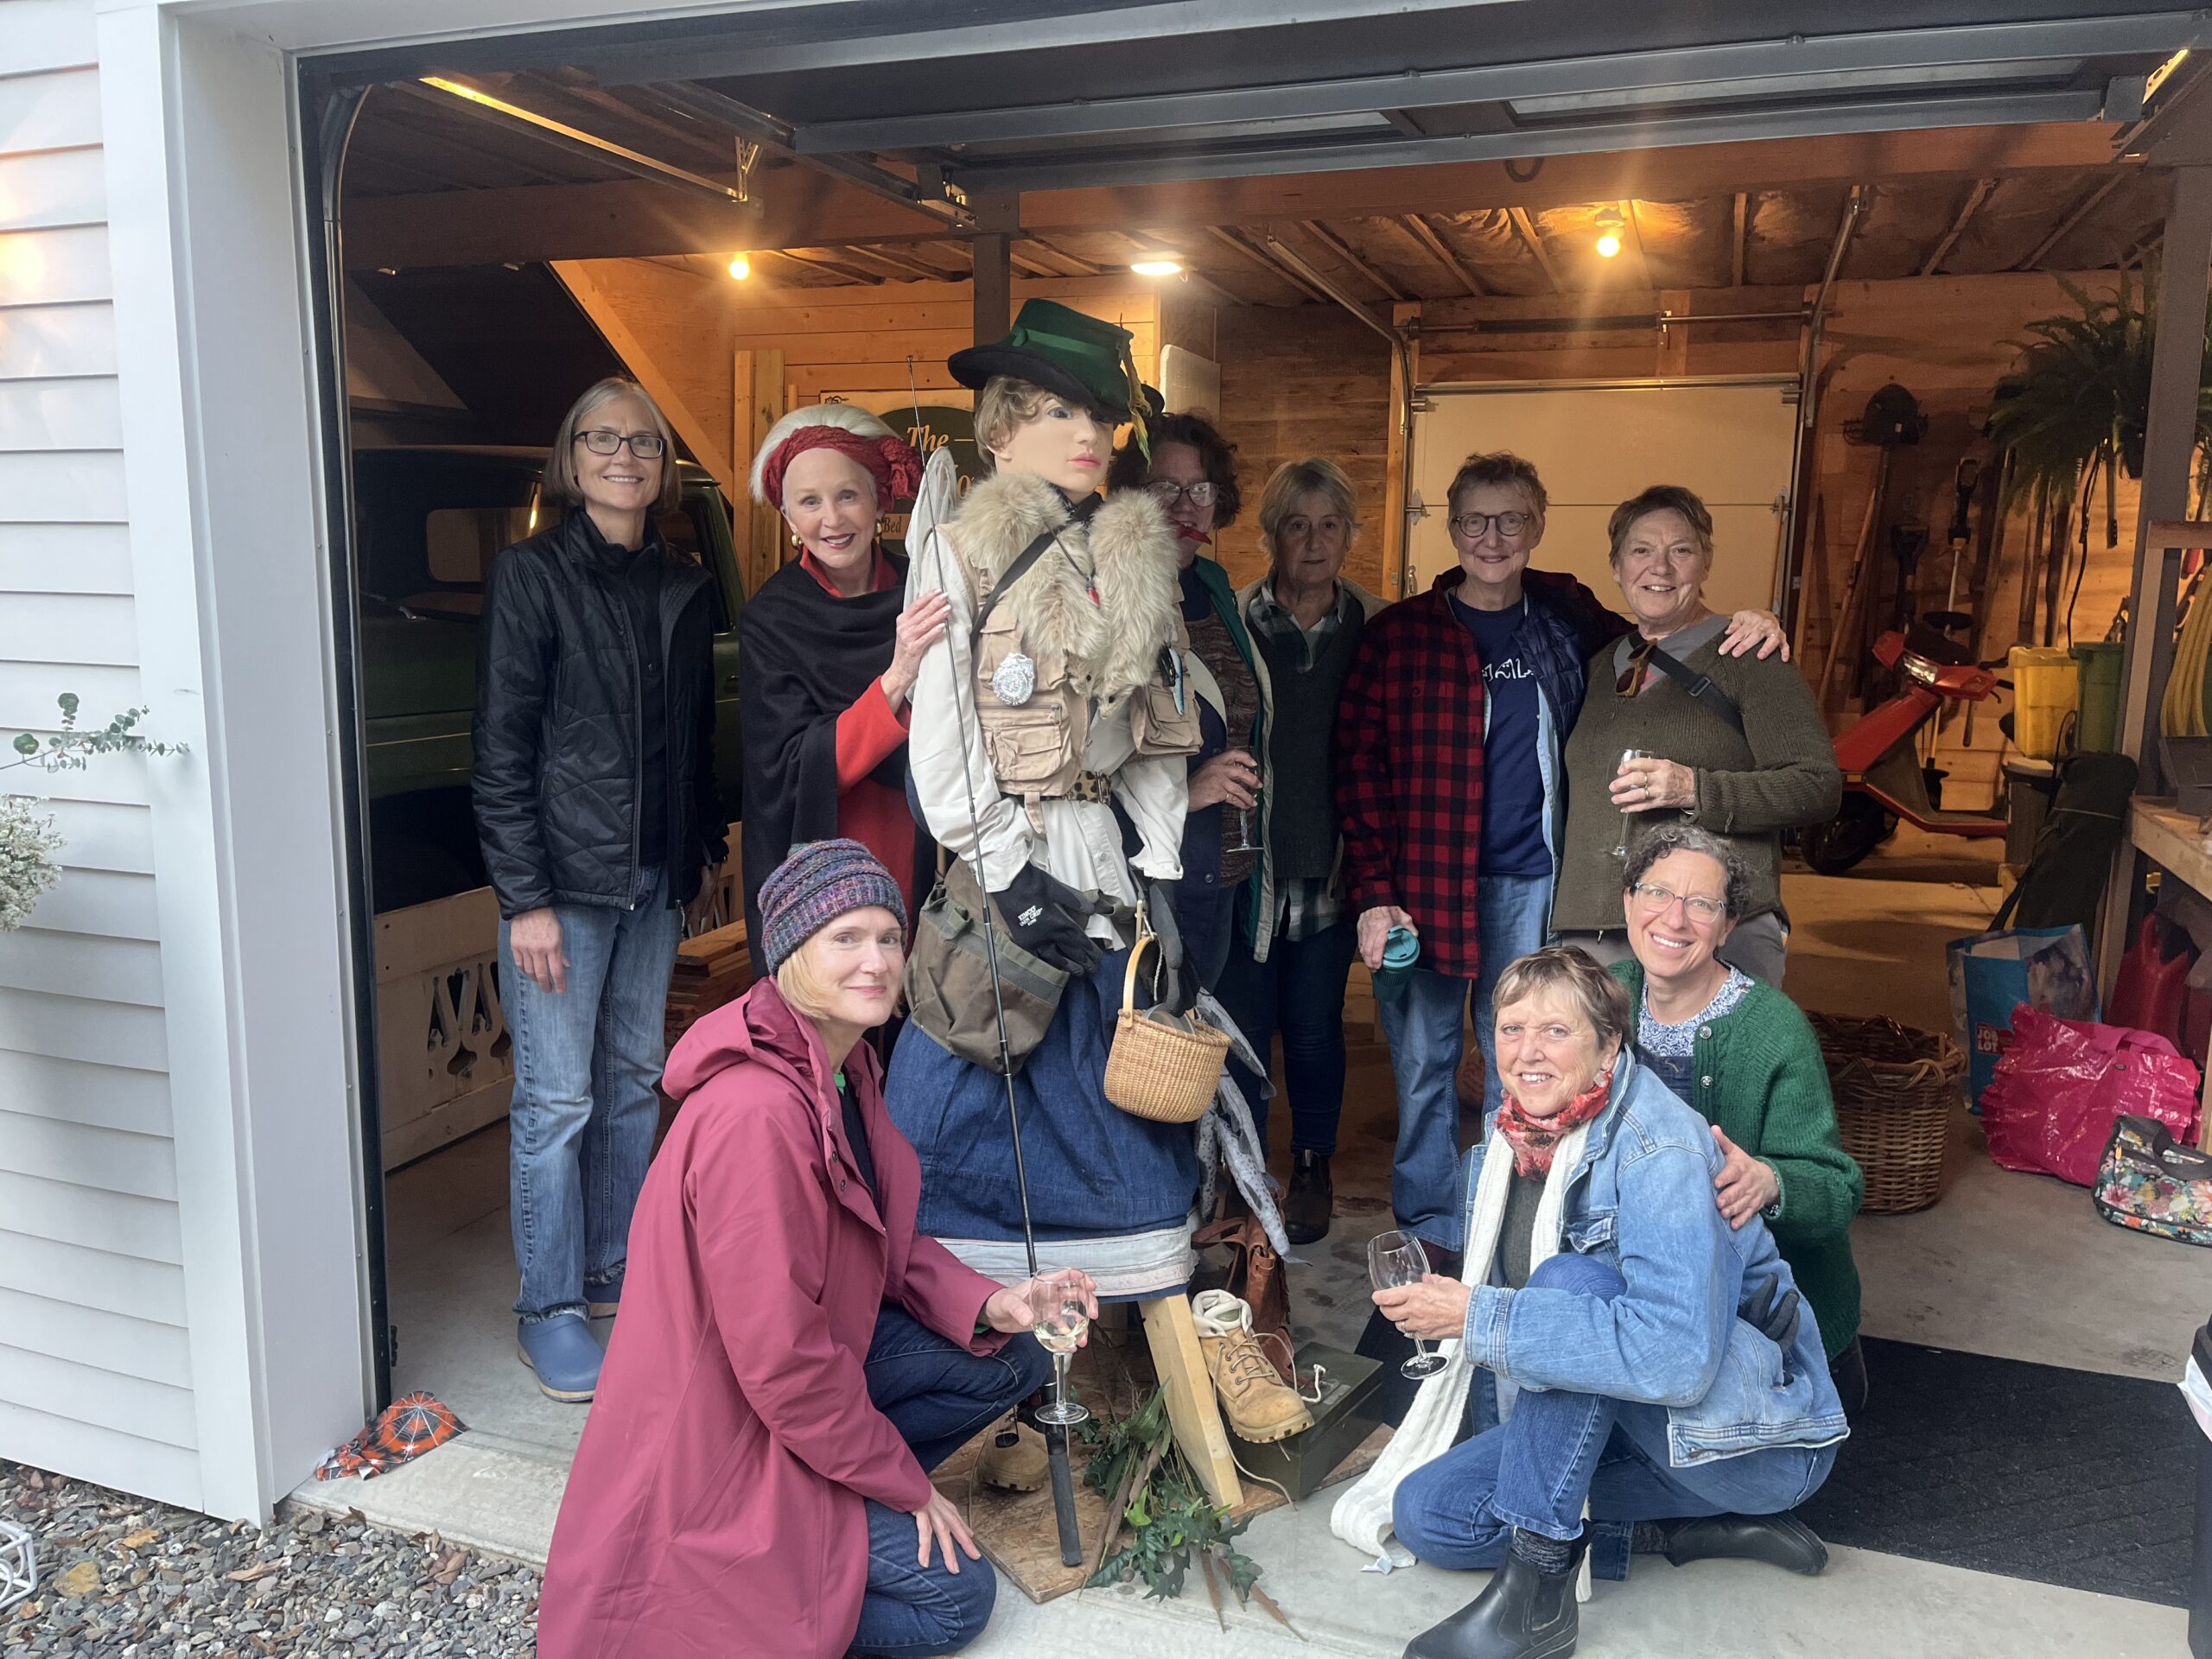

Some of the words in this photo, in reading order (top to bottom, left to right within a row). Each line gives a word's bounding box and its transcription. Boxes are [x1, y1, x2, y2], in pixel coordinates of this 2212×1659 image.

[907, 425, 949, 452] The
[882, 516, 902, 533] Bed
[1978, 1028, 1999, 1041] JOB
[1978, 1040, 1998, 1052] LOT
